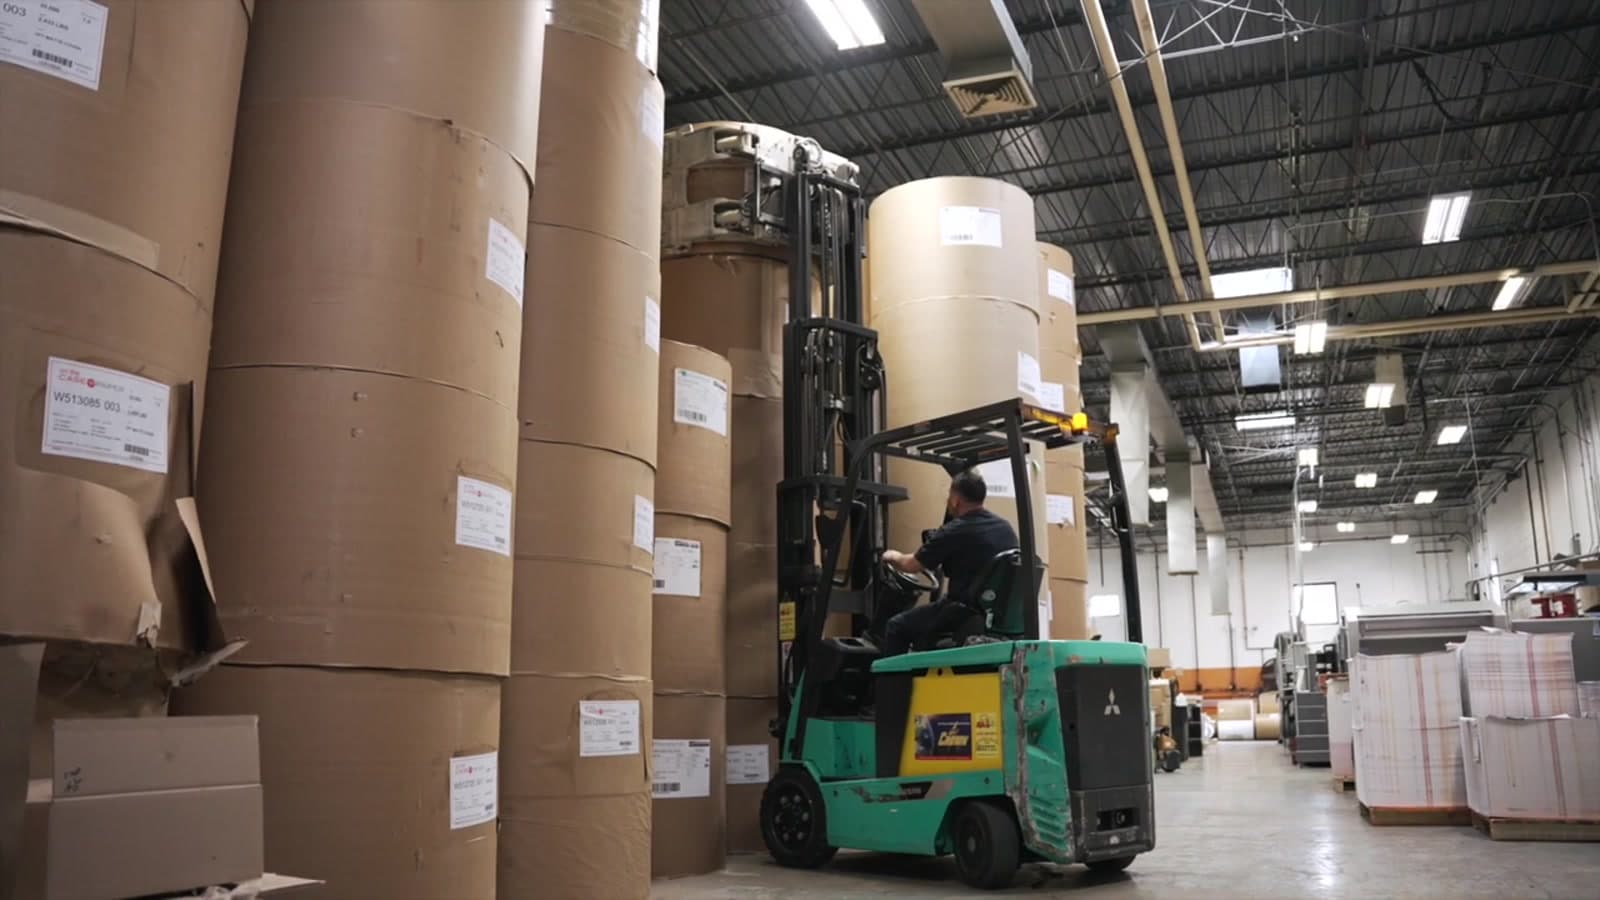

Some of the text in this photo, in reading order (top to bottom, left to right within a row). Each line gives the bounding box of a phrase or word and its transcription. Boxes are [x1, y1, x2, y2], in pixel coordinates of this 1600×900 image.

[2, 2, 27, 17] 003
[53, 391, 121, 413] W513085 003
